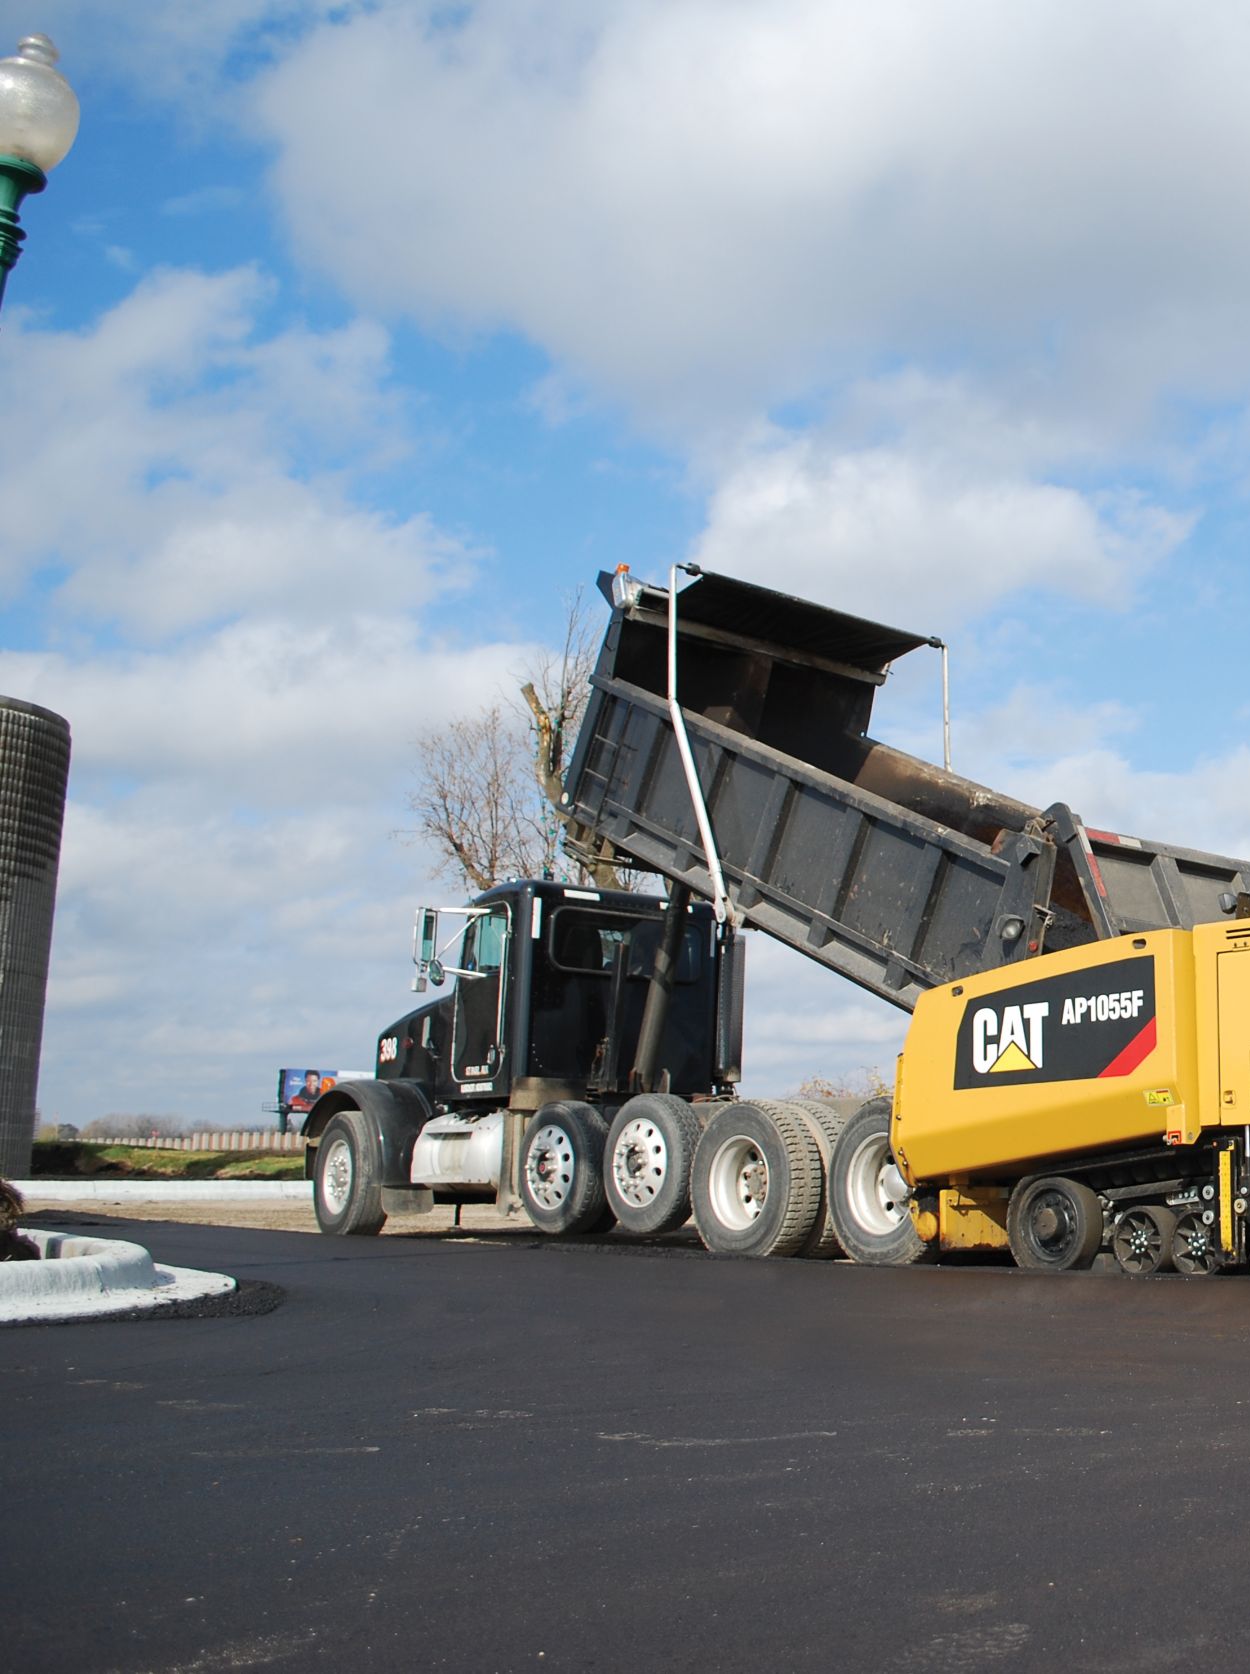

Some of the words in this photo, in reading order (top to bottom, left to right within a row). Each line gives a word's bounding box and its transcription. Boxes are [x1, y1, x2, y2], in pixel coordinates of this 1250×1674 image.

[1061, 990, 1144, 1025] AP1055F
[380, 1036, 397, 1063] 398
[972, 1001, 1049, 1073] CAT
